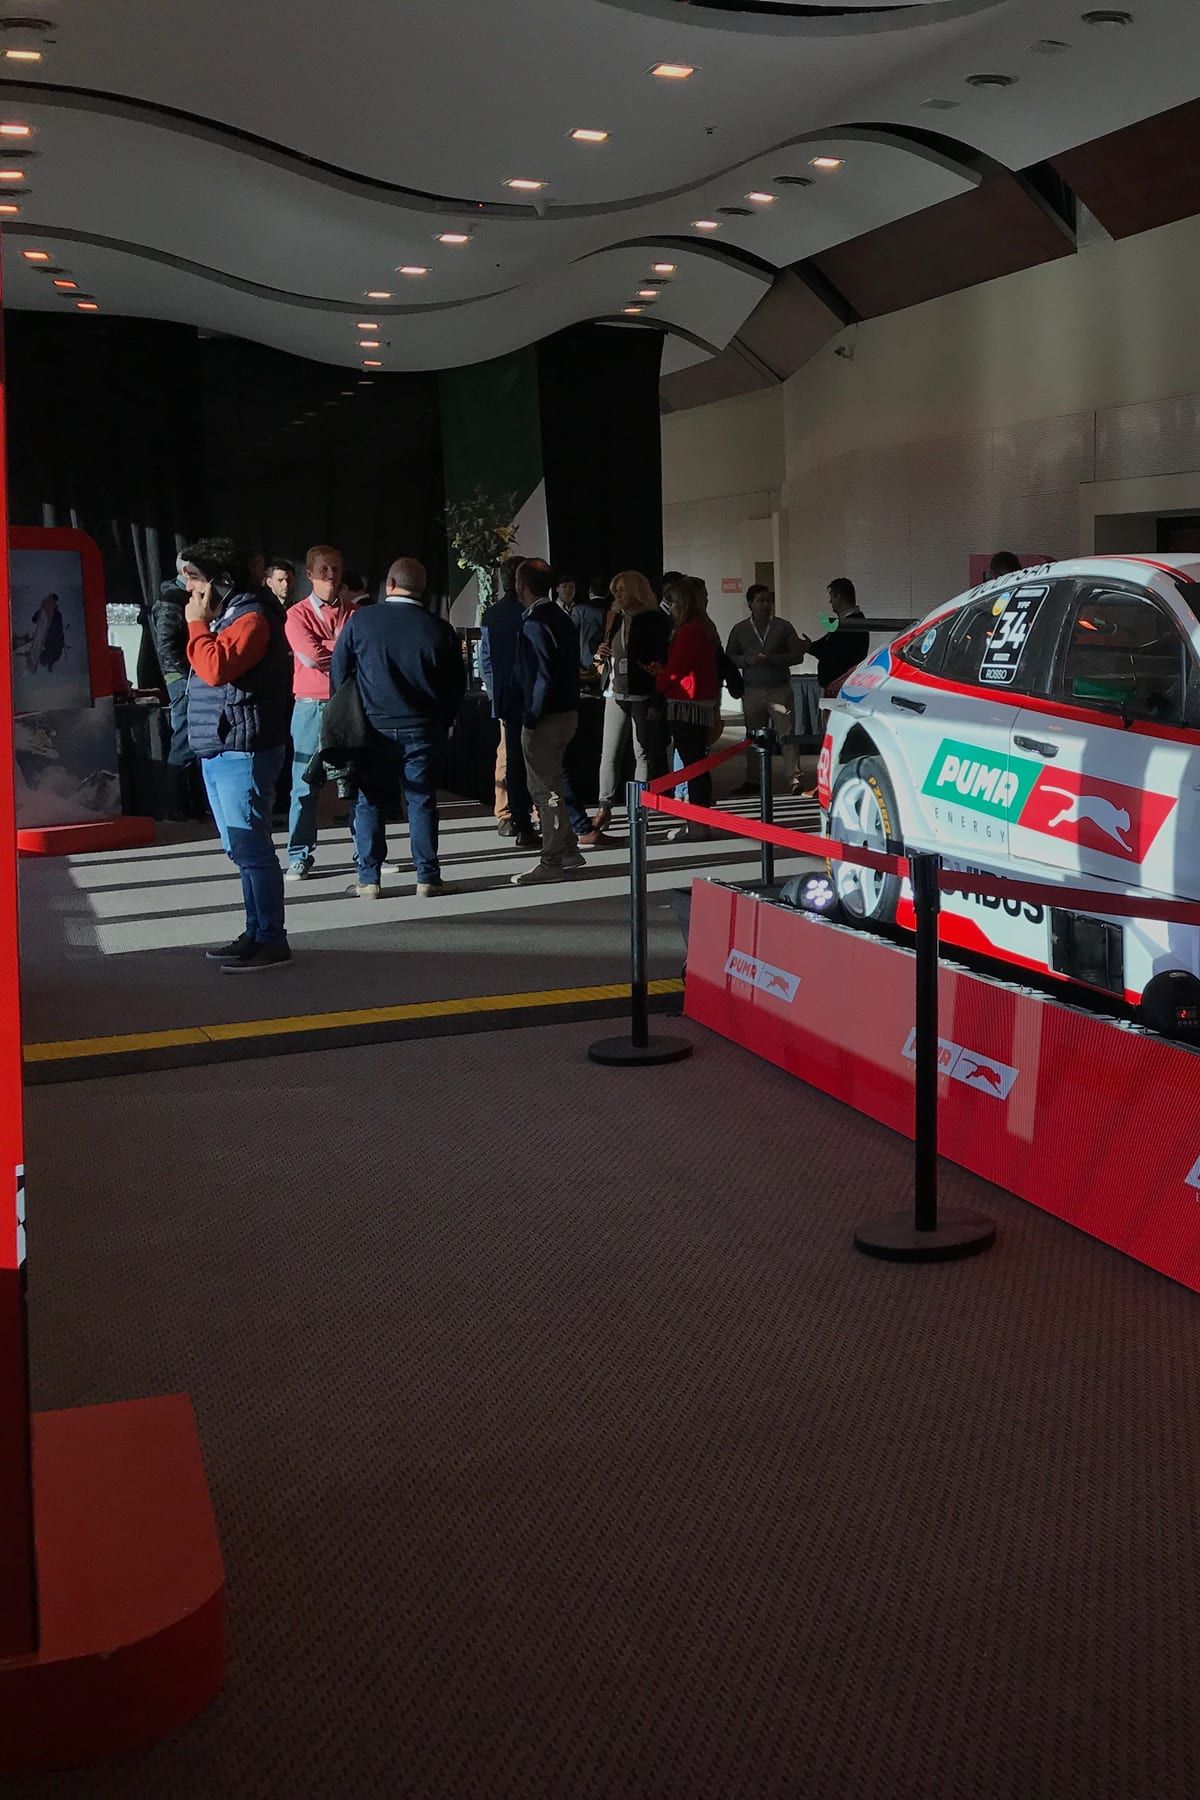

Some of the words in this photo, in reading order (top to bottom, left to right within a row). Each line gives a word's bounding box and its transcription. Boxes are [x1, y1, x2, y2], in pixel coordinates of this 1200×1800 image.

[989, 611, 1028, 649] 34
[985, 669, 1008, 680] ROSSO
[936, 754, 1019, 808] PUMA
[935, 807, 1007, 844] ENERGY
[730, 955, 757, 979] PUMA
